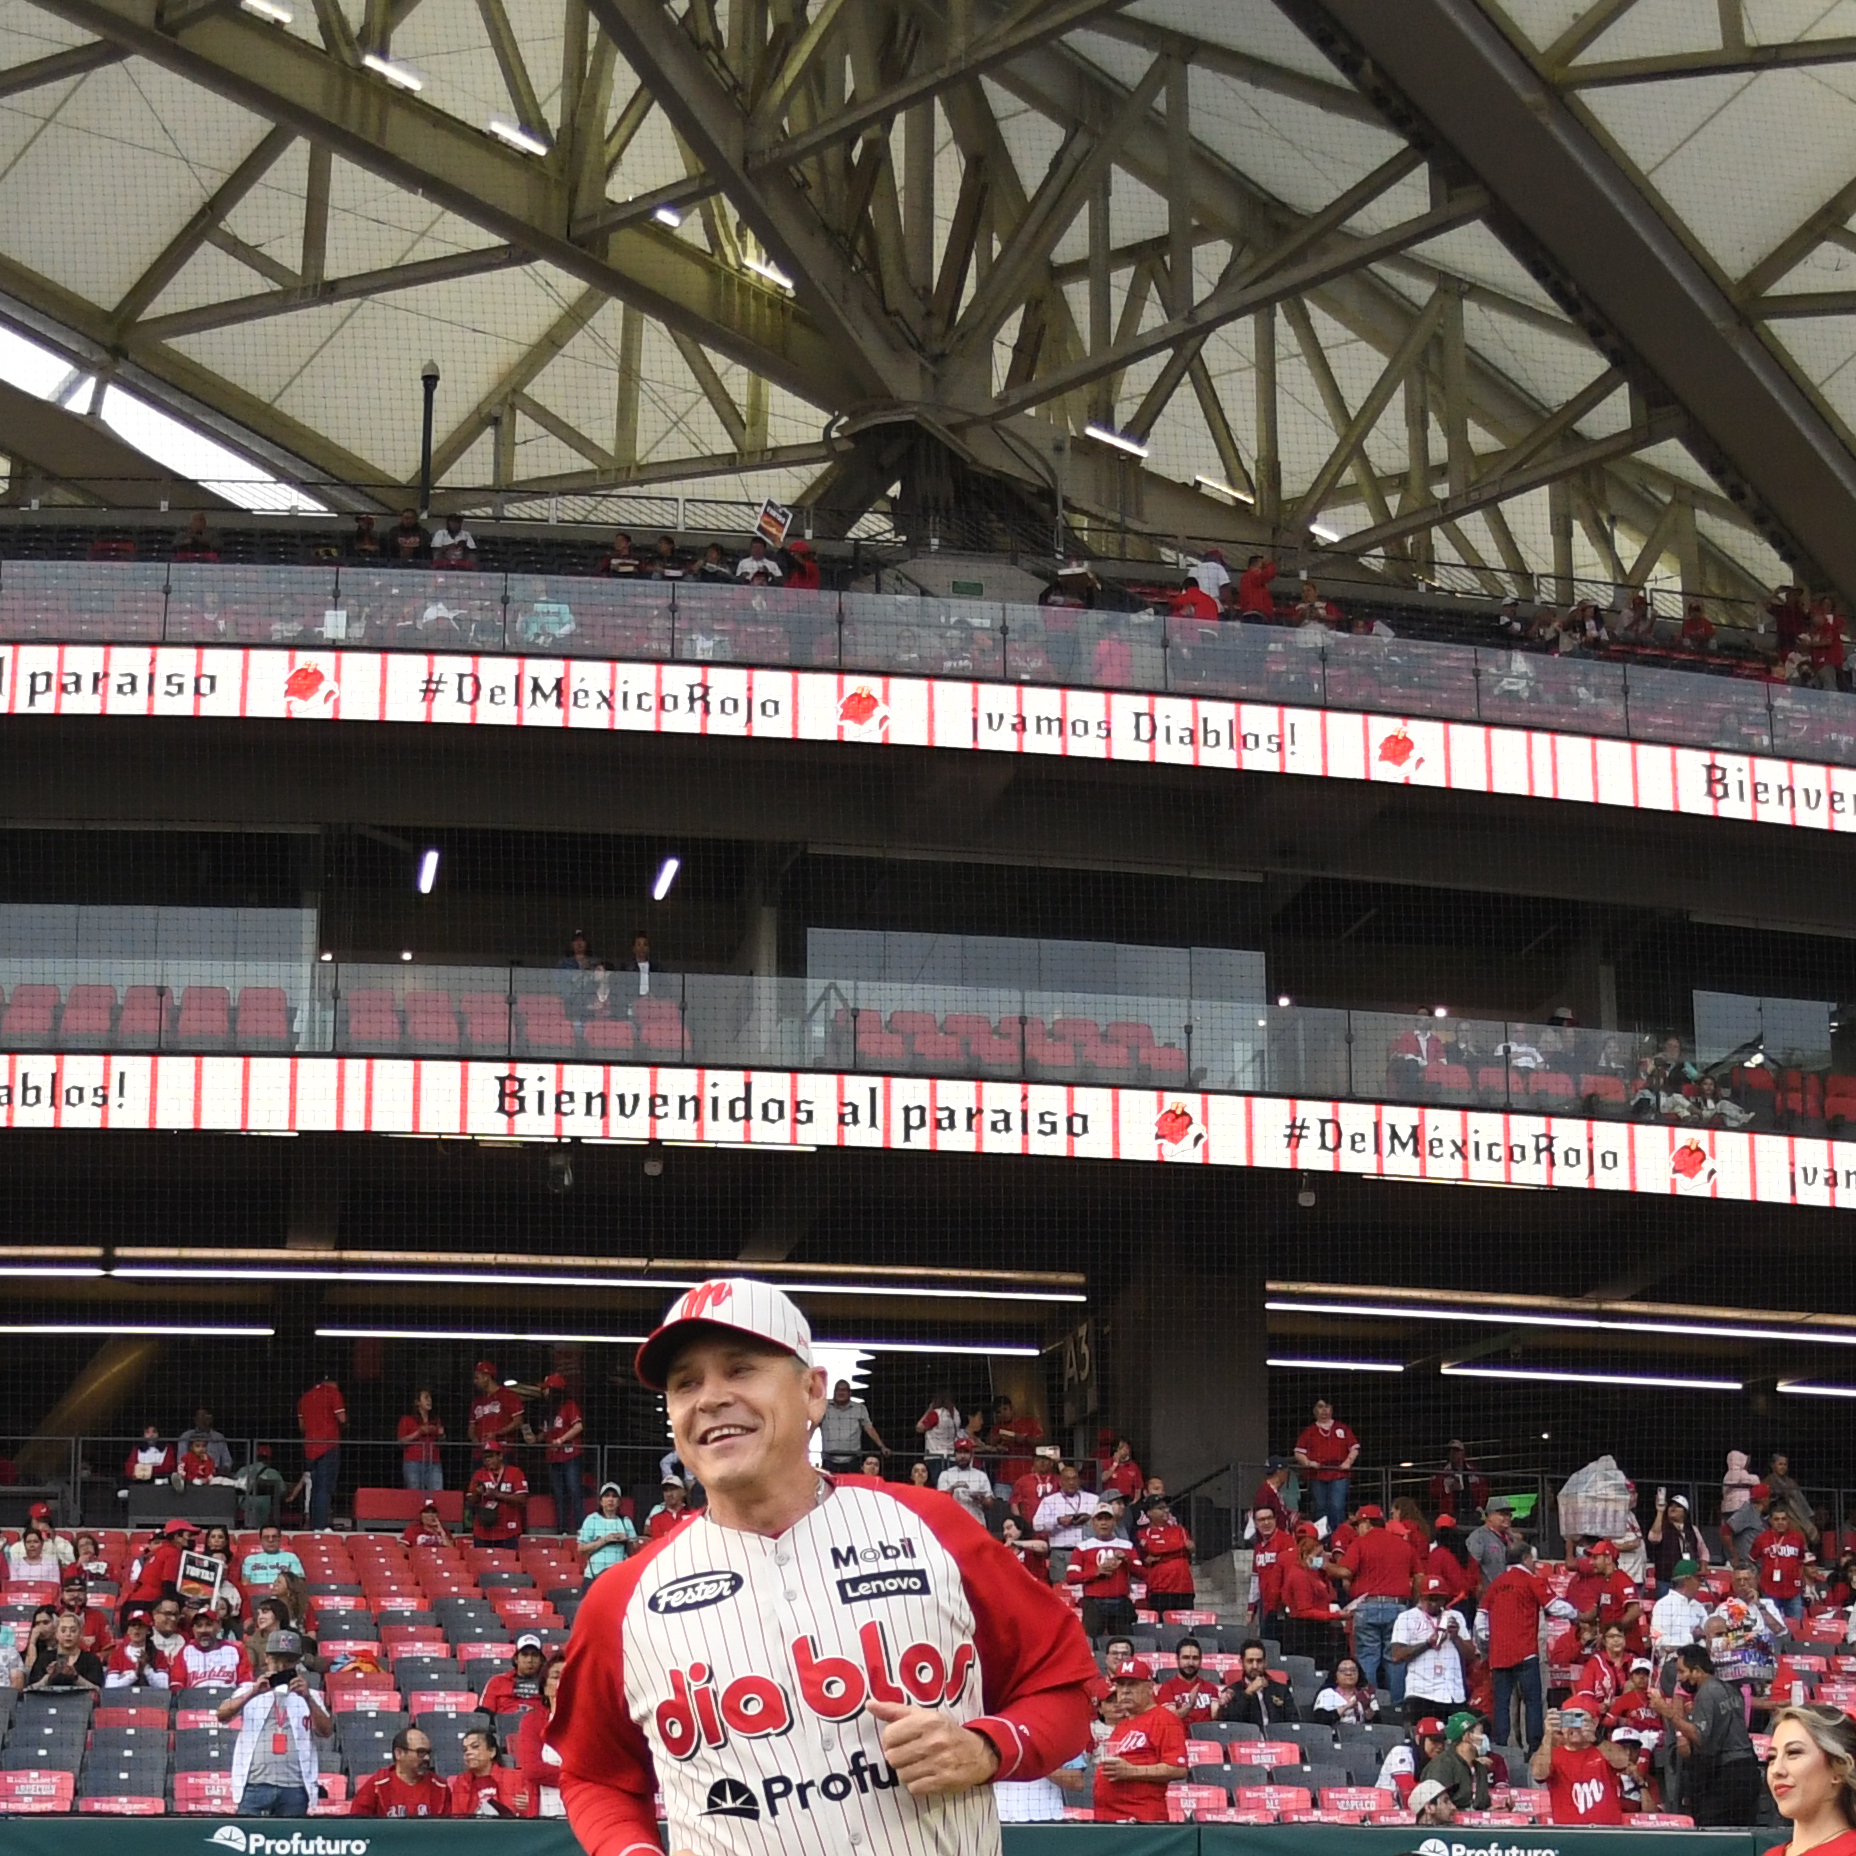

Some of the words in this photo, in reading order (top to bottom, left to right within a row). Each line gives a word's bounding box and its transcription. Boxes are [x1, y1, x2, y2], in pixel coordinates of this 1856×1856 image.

[419, 673, 781, 727] #DelMéxicoRojo
[1133, 711, 1298, 756] Diablos!
[493, 1073, 815, 1127] Bienvenidos
[838, 1076, 879, 1131] al
[1282, 1116, 1619, 1180] #DelMéxicoRojo
[831, 1537, 915, 1569] Mobil
[656, 1572, 733, 1612] Fester
[845, 1574, 921, 1598] Lenovo
[655, 1620, 975, 1761] diablos
[248, 1832, 367, 1856] Profuturo
